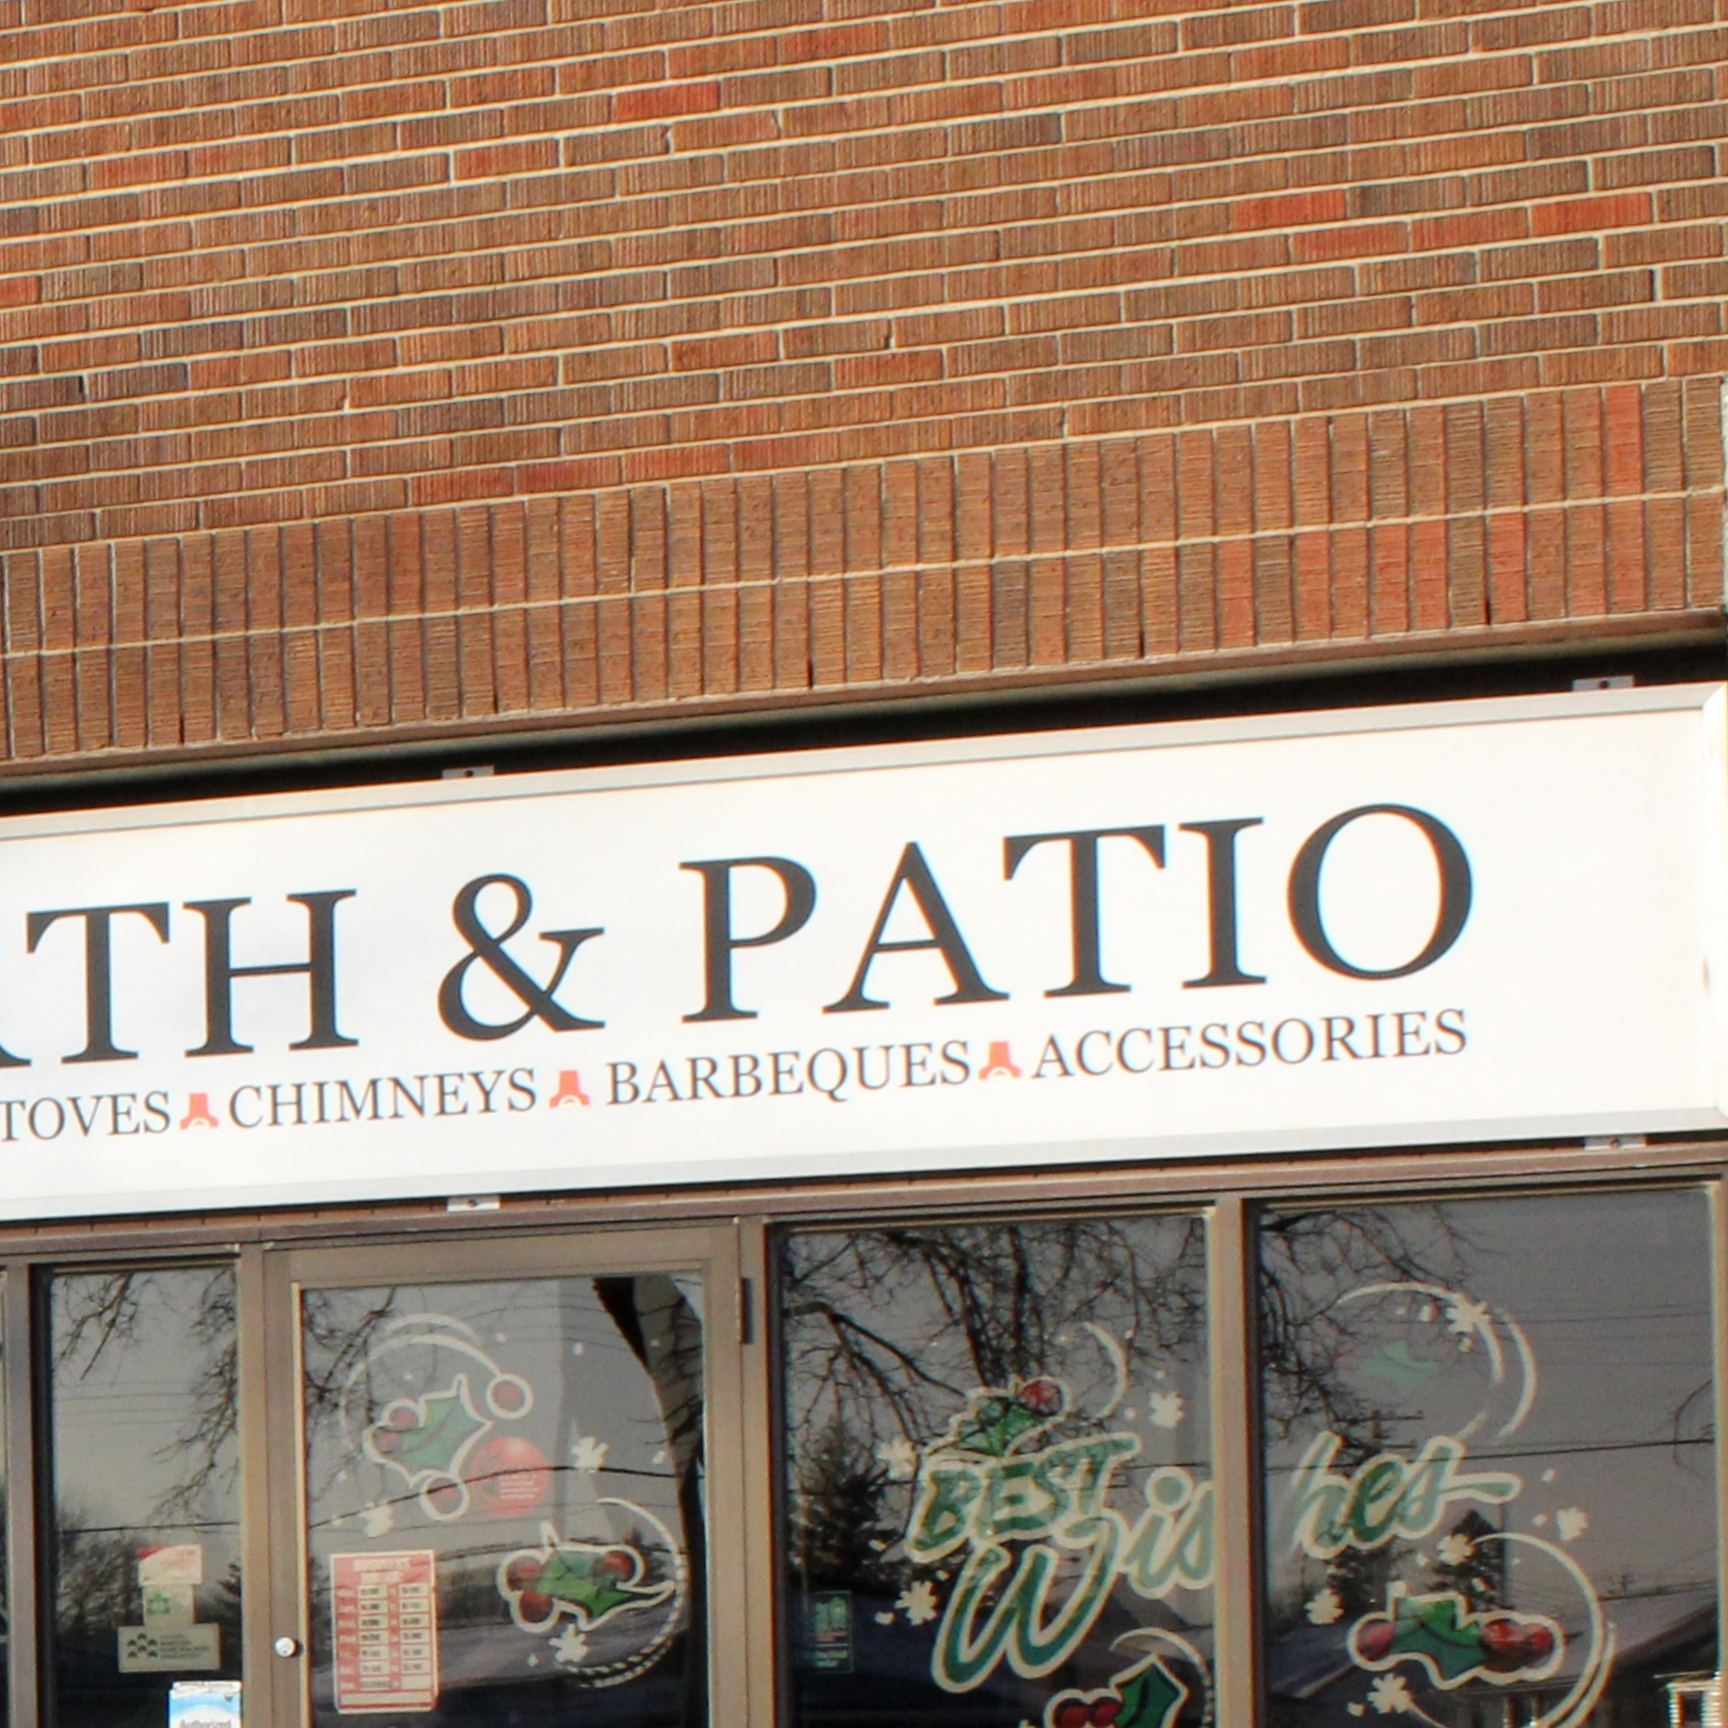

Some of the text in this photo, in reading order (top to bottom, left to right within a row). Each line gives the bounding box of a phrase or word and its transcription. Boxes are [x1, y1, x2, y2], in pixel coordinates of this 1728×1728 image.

[436, 872, 606, 1042] &
[678, 802, 1474, 1025] PATIO
[228, 1067, 538, 1130] CHIMNEYS
[605, 1038, 971, 1104] BARBEQUES
[1030, 1007, 1469, 1080] ACCESSORIES
